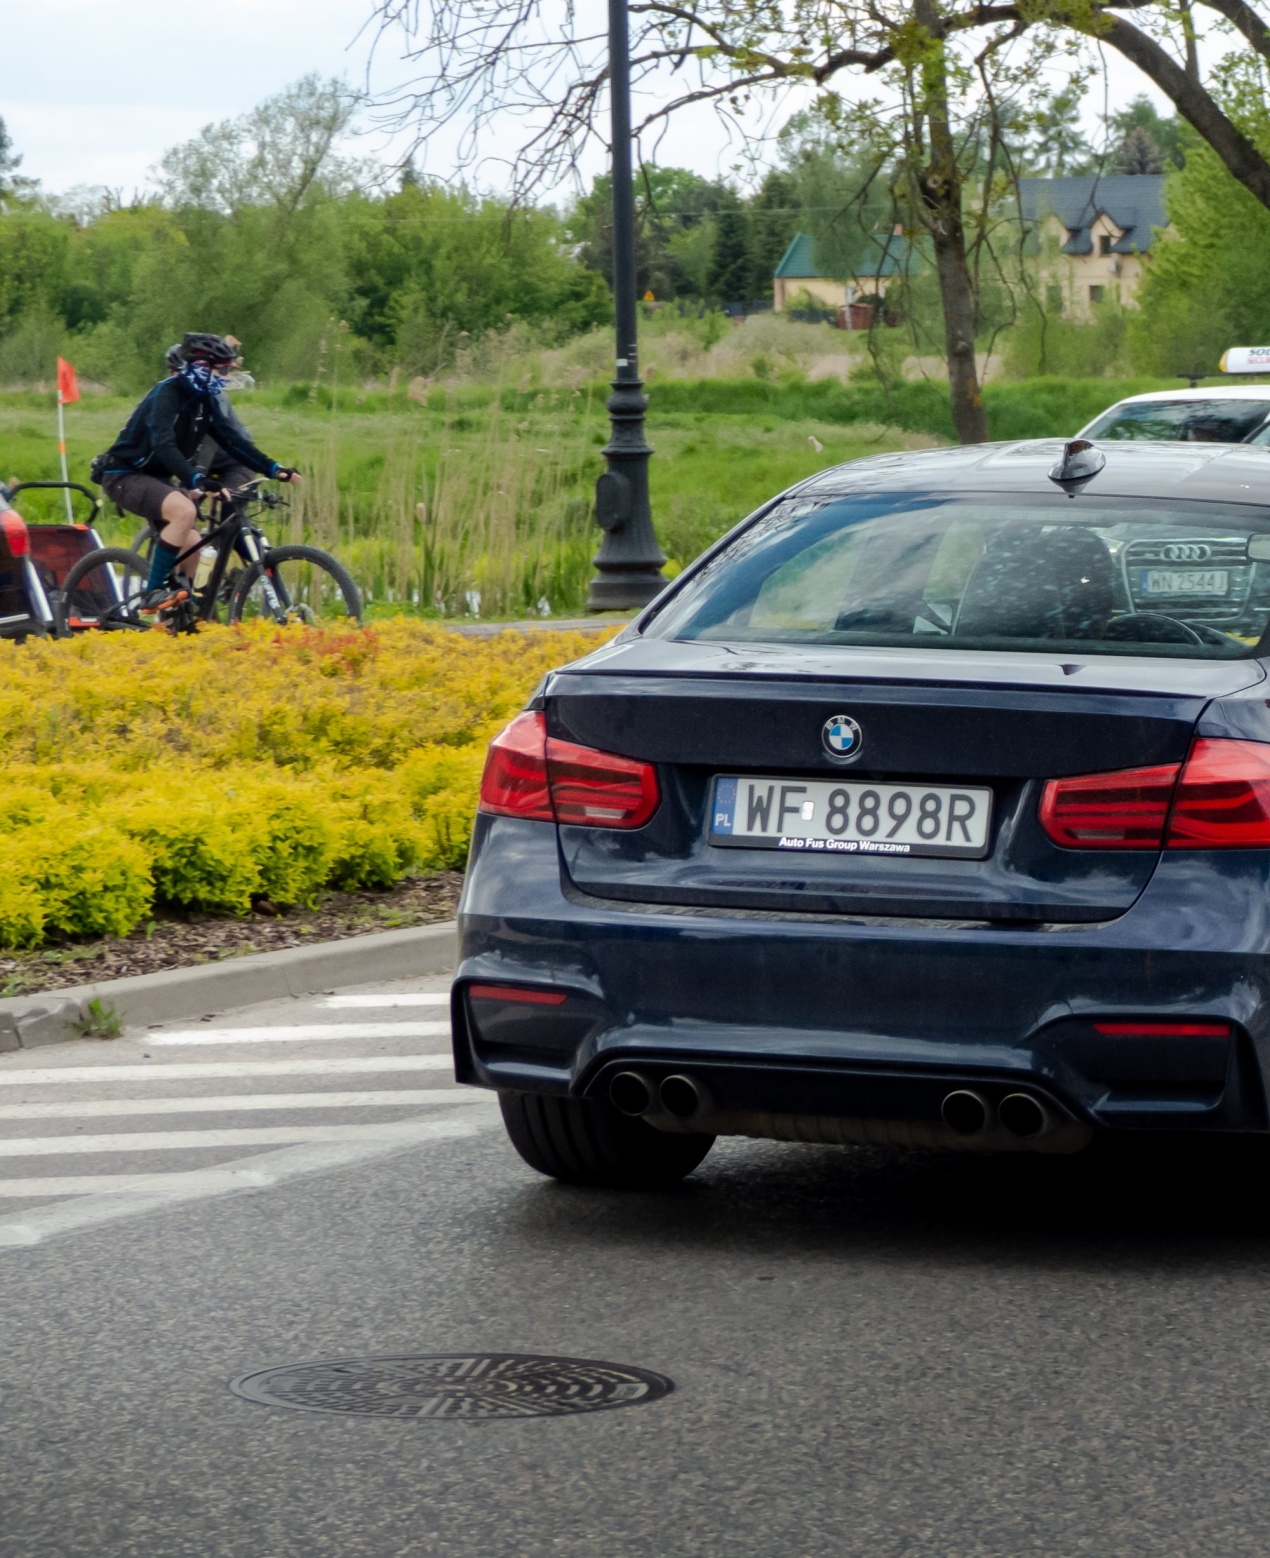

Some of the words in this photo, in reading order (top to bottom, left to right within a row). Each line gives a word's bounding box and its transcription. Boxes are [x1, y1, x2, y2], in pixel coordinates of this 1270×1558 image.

[1178, 573, 1225, 591] 2544J
[825, 716, 859, 731] BMW
[714, 813, 732, 828] PL
[746, 784, 808, 834] WF
[825, 788, 976, 842] 8898R
[779, 837, 804, 848] Auto
[805, 838, 825, 849] Fus
[826, 839, 858, 851] Group
[859, 841, 911, 853] Warszawa
